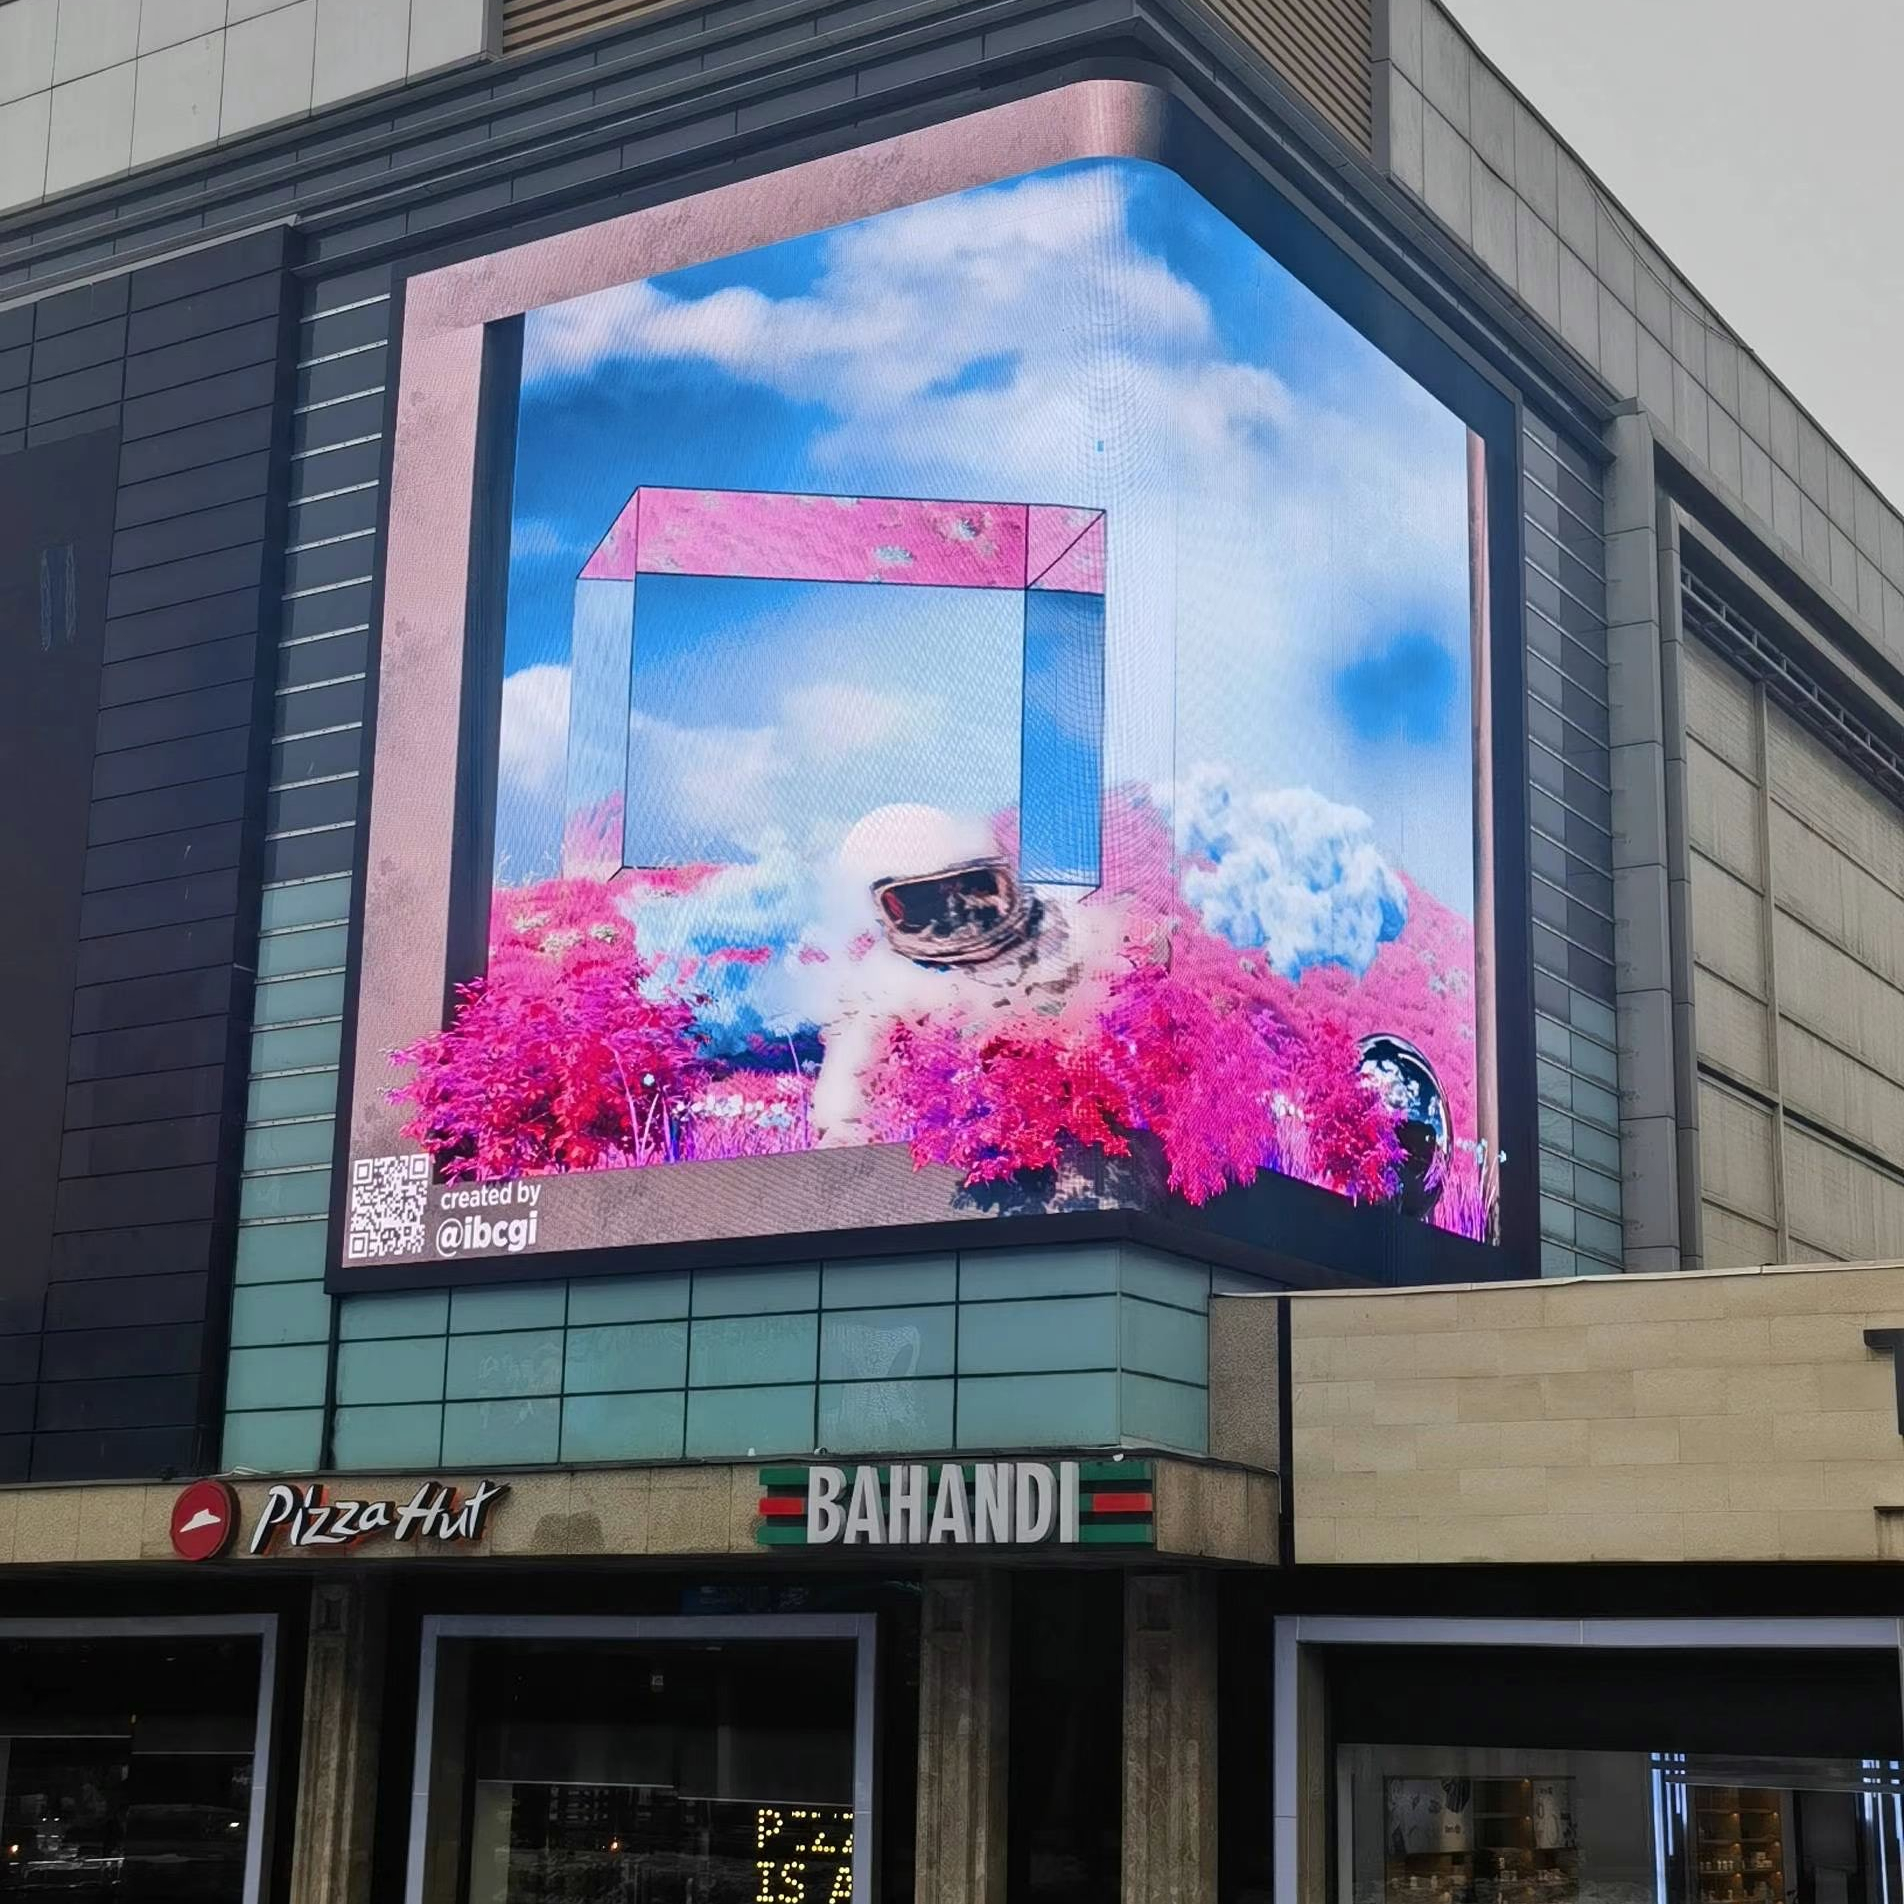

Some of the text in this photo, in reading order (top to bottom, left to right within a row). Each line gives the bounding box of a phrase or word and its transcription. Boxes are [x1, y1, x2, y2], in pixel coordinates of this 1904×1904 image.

[440, 1181, 541, 1210] created by
[436, 1211, 538, 1257] @ibcgi
[250, 1479, 506, 1554] Pizza Hut
[806, 1462, 1080, 1544] BAHANDI
[757, 1861, 806, 1903] IS
